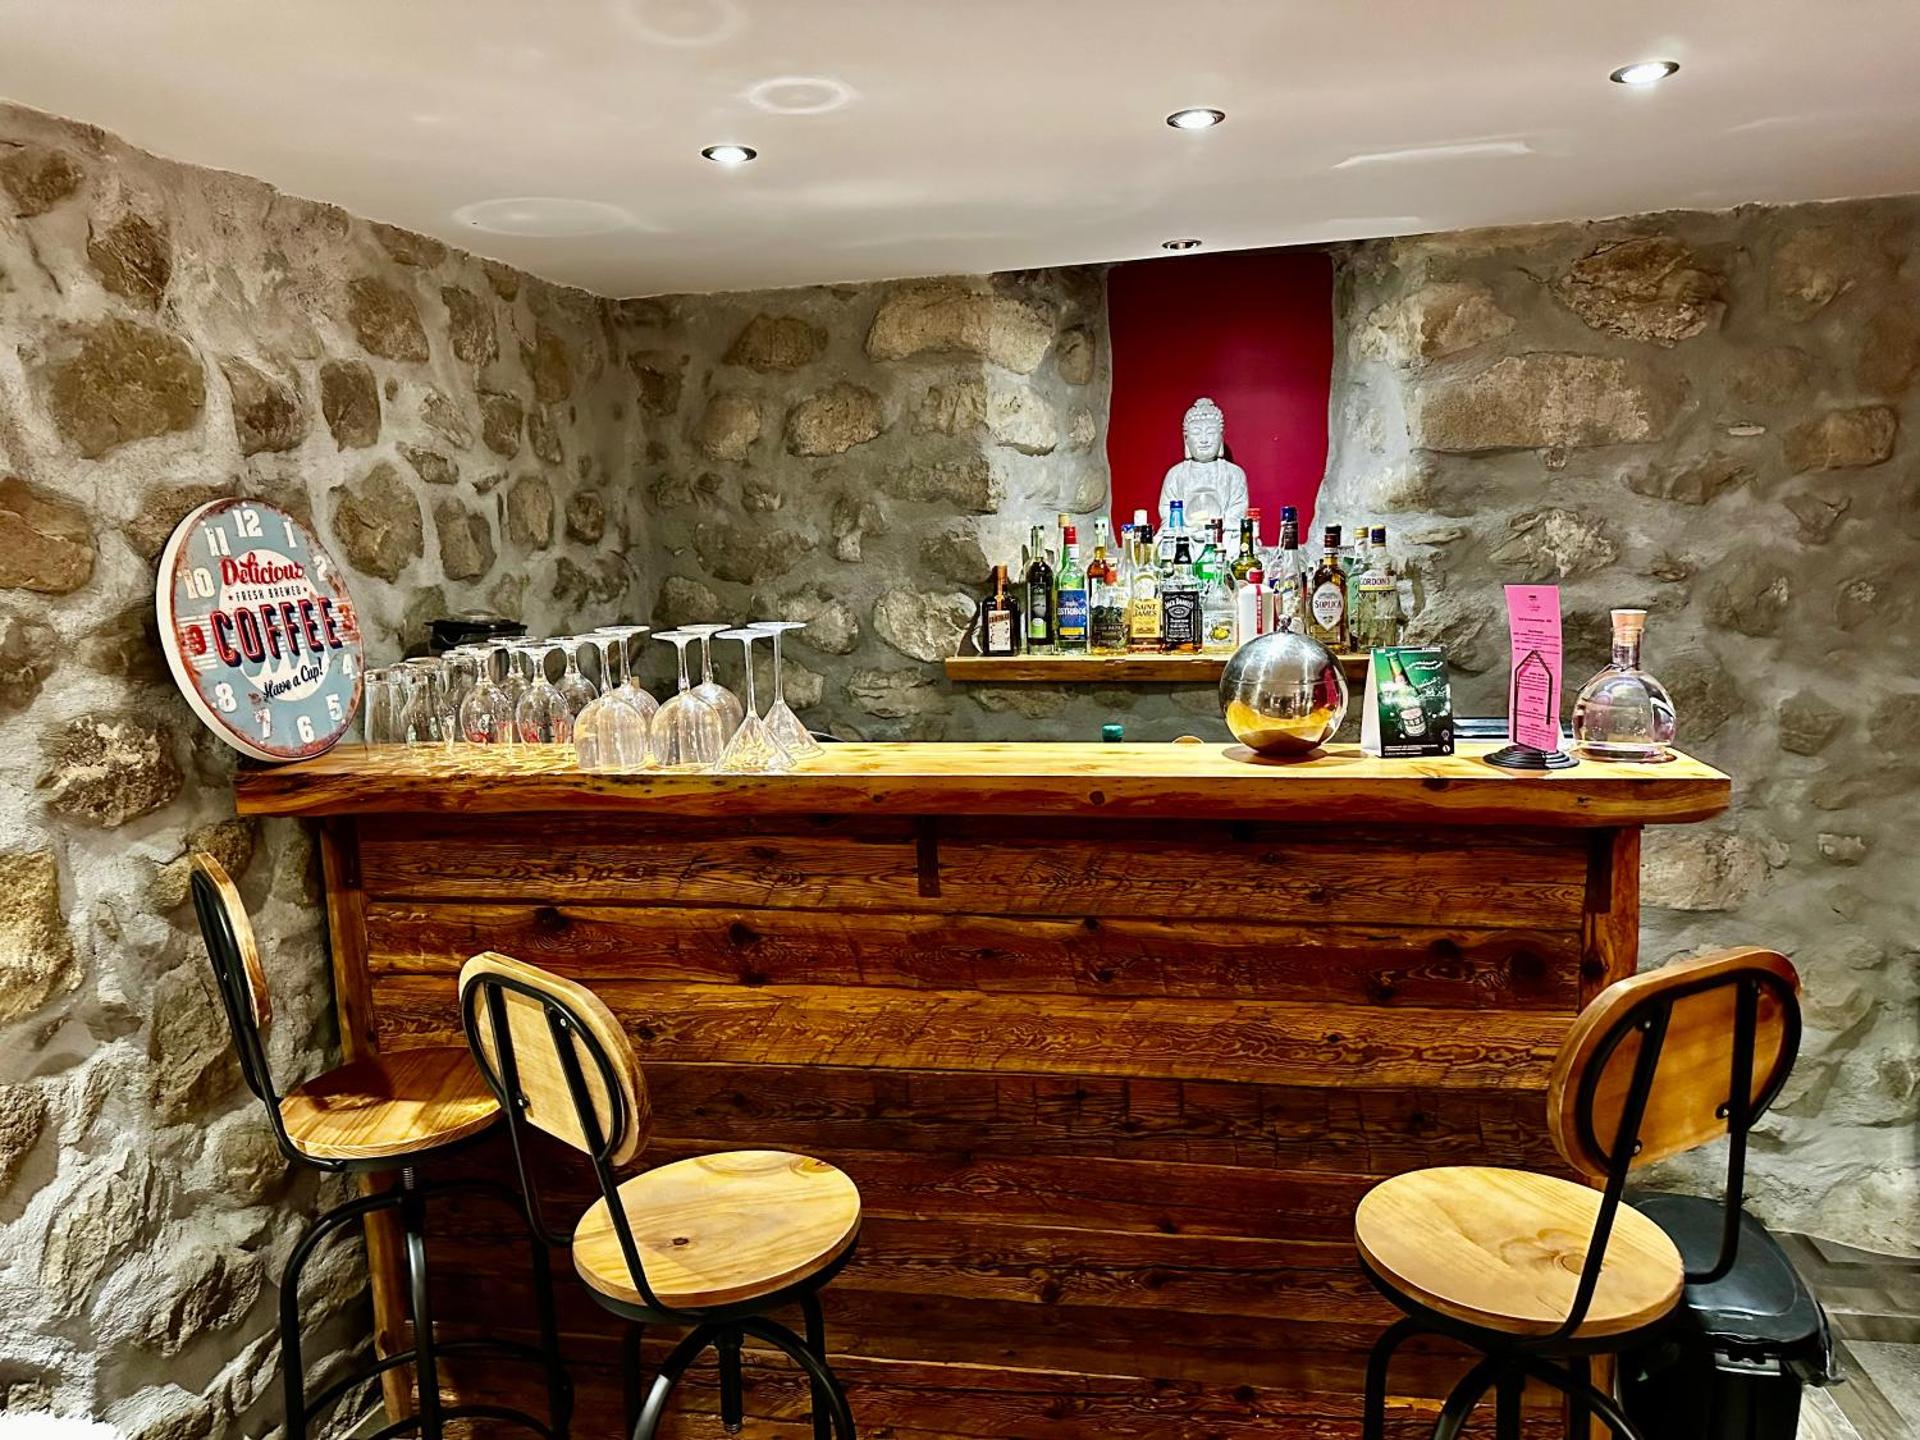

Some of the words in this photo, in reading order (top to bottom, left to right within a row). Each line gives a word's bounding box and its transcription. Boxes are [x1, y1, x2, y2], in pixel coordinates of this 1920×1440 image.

[232, 509, 263, 537] 12
[283, 521, 297, 548] 1
[204, 527, 231, 556] 11
[181, 567, 216, 599] 10
[219, 552, 305, 586] Delicious
[313, 555, 329, 582] 2
[235, 588, 265, 602] FRESH
[267, 585, 302, 600] BREWED
[210, 596, 343, 667] COFFEE
[262, 678, 293, 702] Have
[292, 675, 302, 688] a
[300, 657, 324, 684] Cup!
[342, 654, 356, 680] 4
[215, 682, 238, 713] 8
[326, 693, 343, 721] 5
[255, 708, 272, 739] 7
[296, 715, 315, 744] 6
